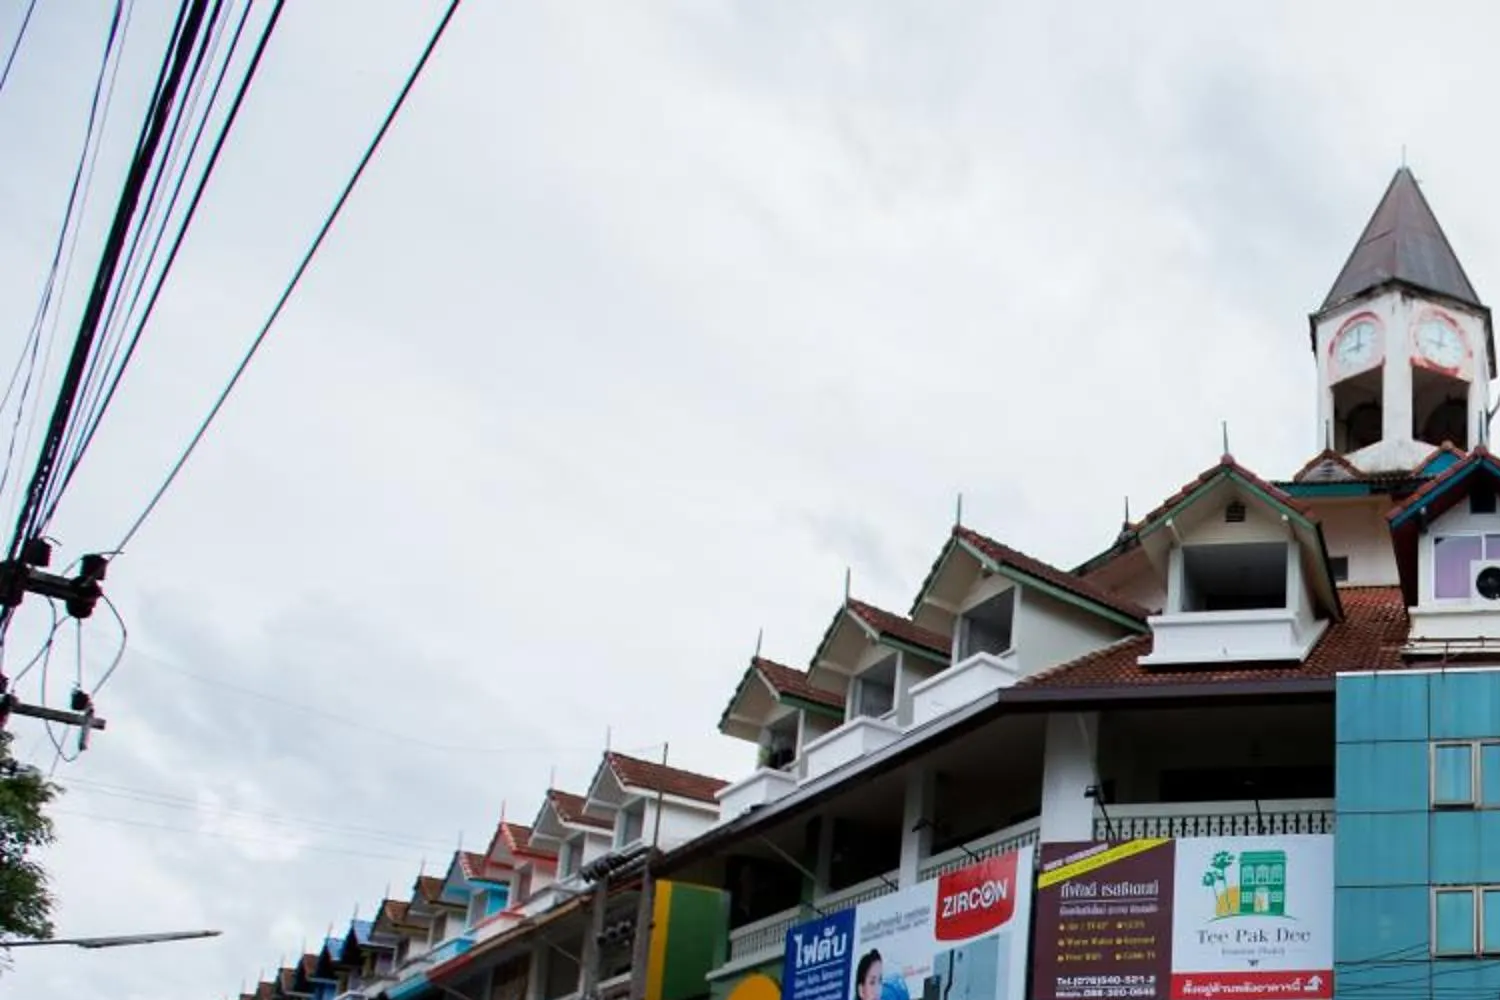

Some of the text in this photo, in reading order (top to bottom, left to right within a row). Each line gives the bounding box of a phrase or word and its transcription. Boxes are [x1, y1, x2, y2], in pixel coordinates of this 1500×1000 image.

[941, 878, 1009, 918] ZIRCON
[1197, 927, 1311, 944] Tee Pak Dee
